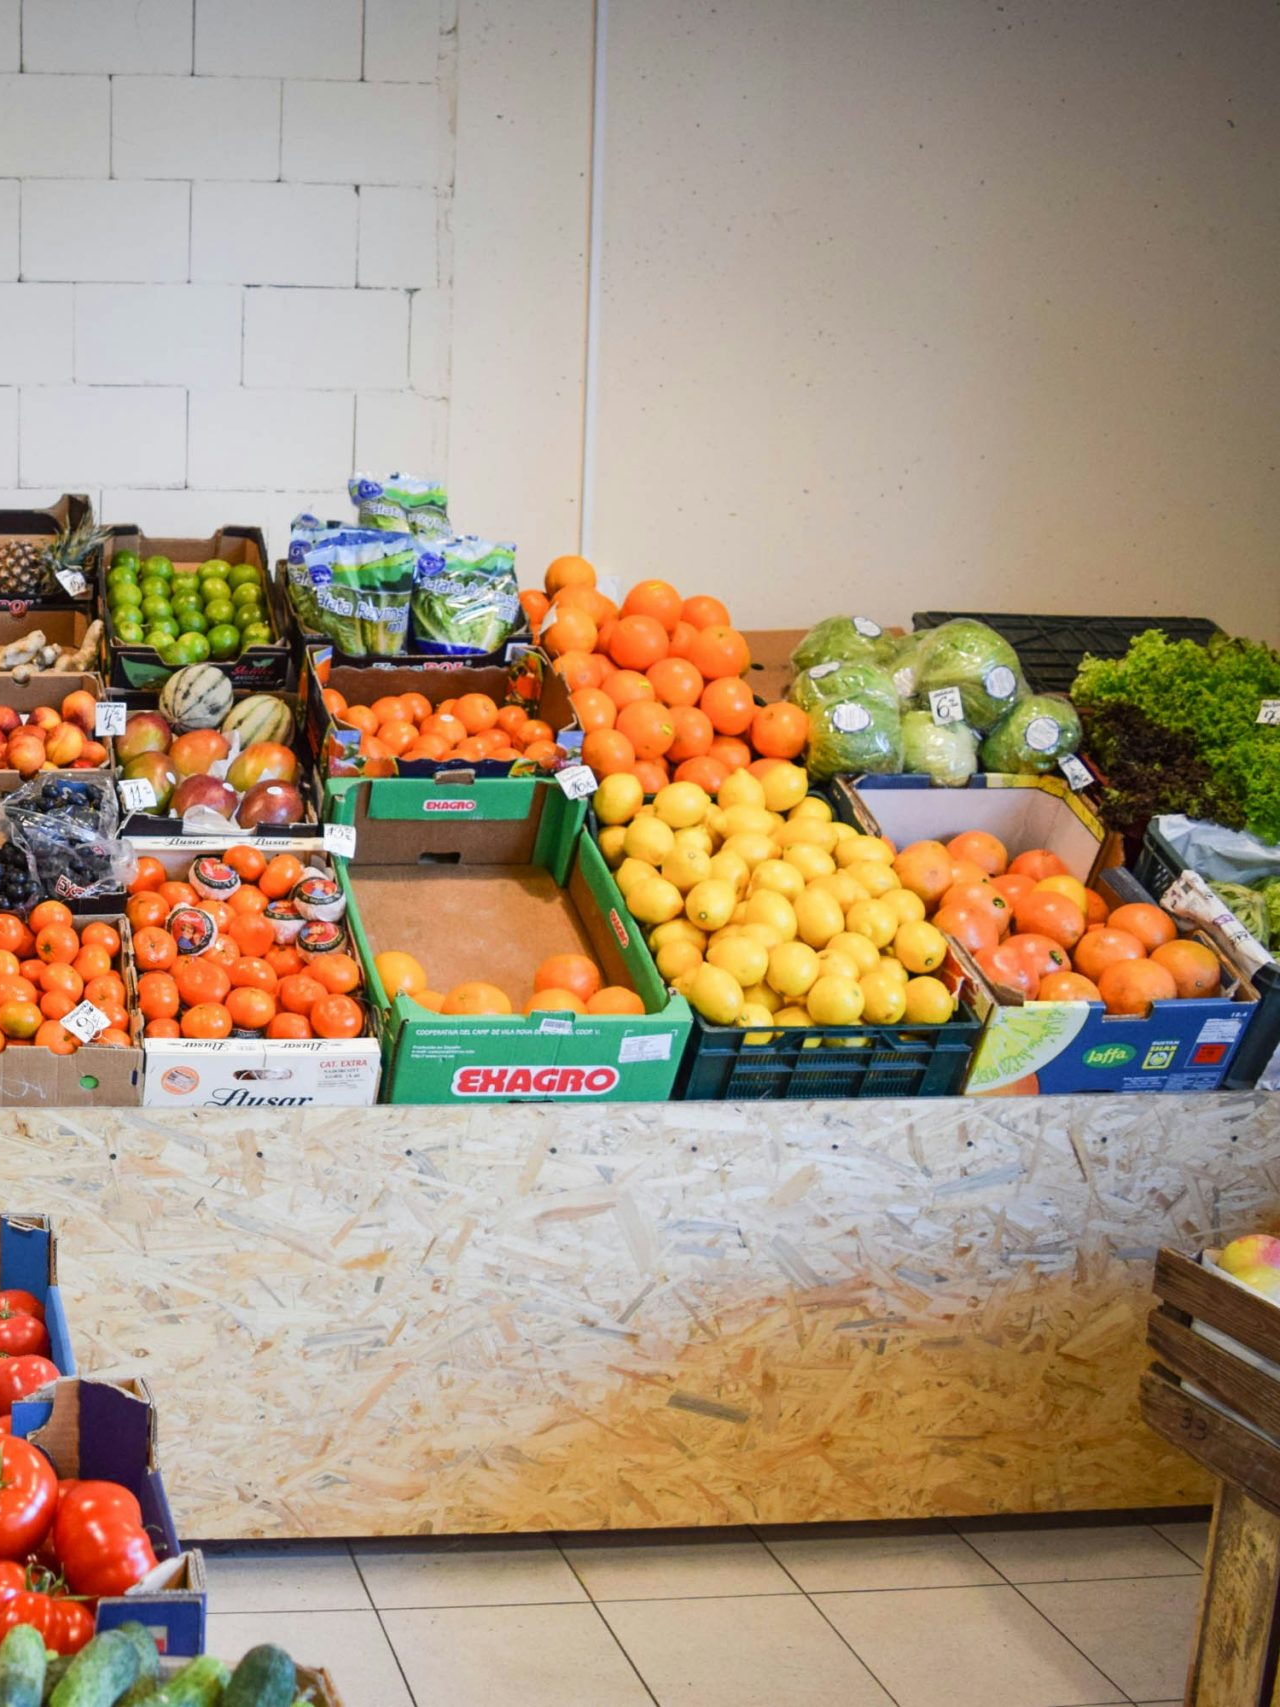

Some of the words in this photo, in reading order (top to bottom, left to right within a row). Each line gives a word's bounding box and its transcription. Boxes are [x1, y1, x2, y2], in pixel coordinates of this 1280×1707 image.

[936, 696, 950, 719] 6
[425, 800, 476, 810] EXAGRO
[340, 1058, 368, 1068] EXTRA
[456, 1067, 618, 1093] EXAGRO
